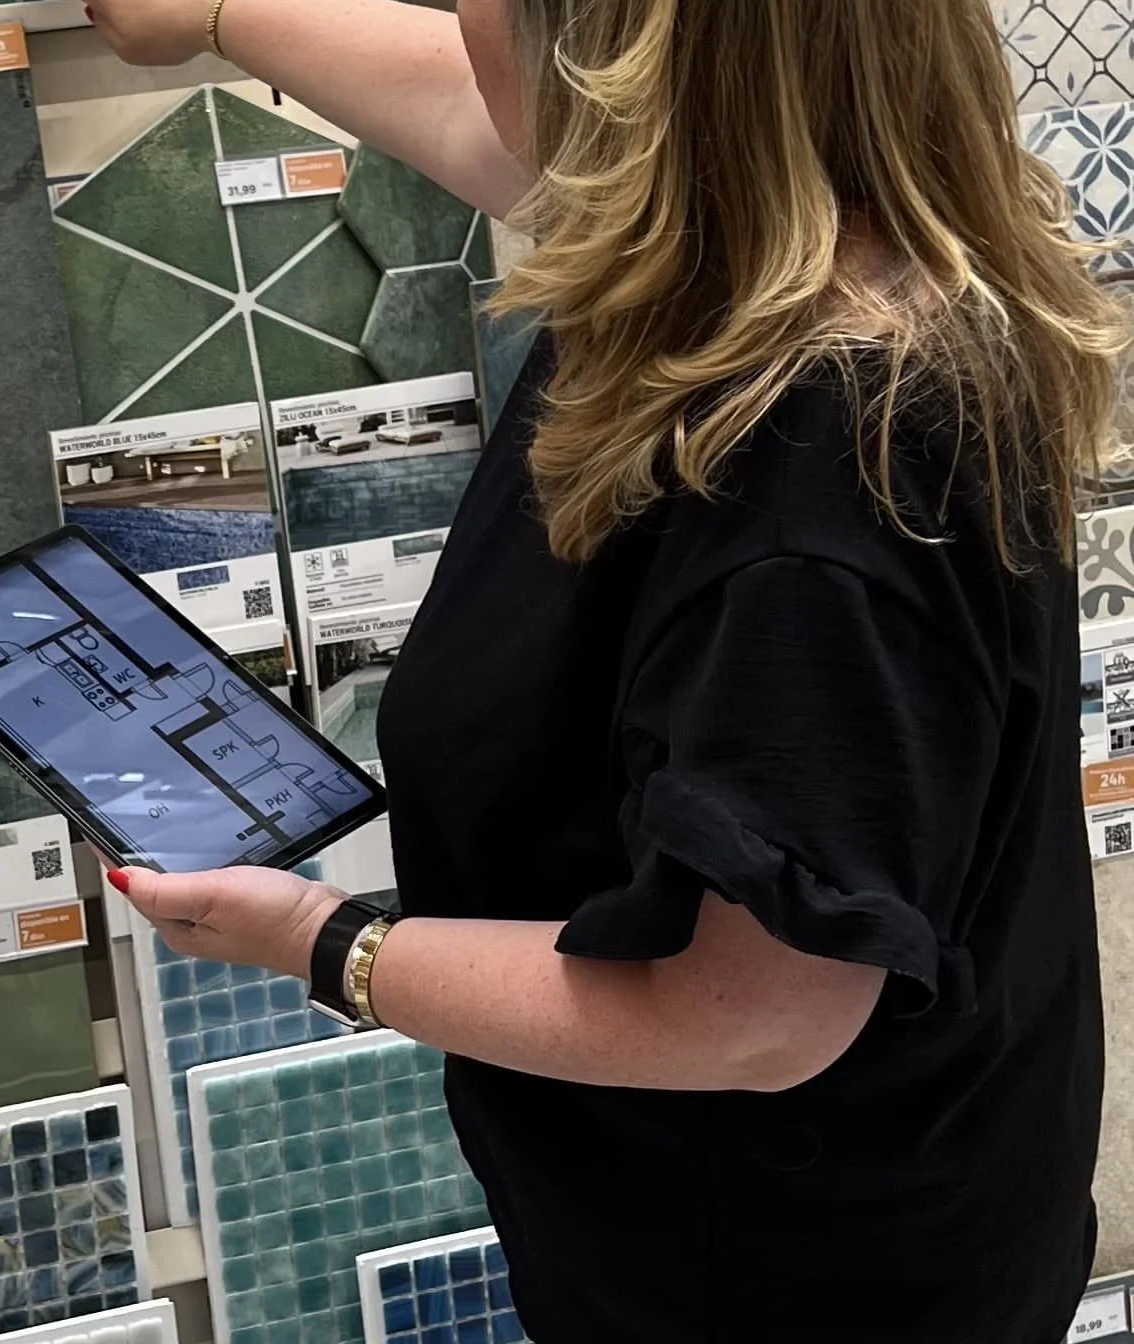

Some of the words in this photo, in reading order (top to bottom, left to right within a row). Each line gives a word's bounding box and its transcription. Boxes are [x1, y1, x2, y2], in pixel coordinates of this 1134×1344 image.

[227, 184, 257, 197] 31,99
[59, 439, 112, 453] WATERWORLD
[113, 435, 132, 445] BLUE
[320, 624, 370, 639] WATERWORLD
[113, 667, 136, 685] WC
[32, 695, 46, 707] K
[212, 740, 240, 761] SPK
[1100, 773, 1126, 788] 24h
[265, 789, 293, 810] PKH
[148, 803, 170, 819] OH
